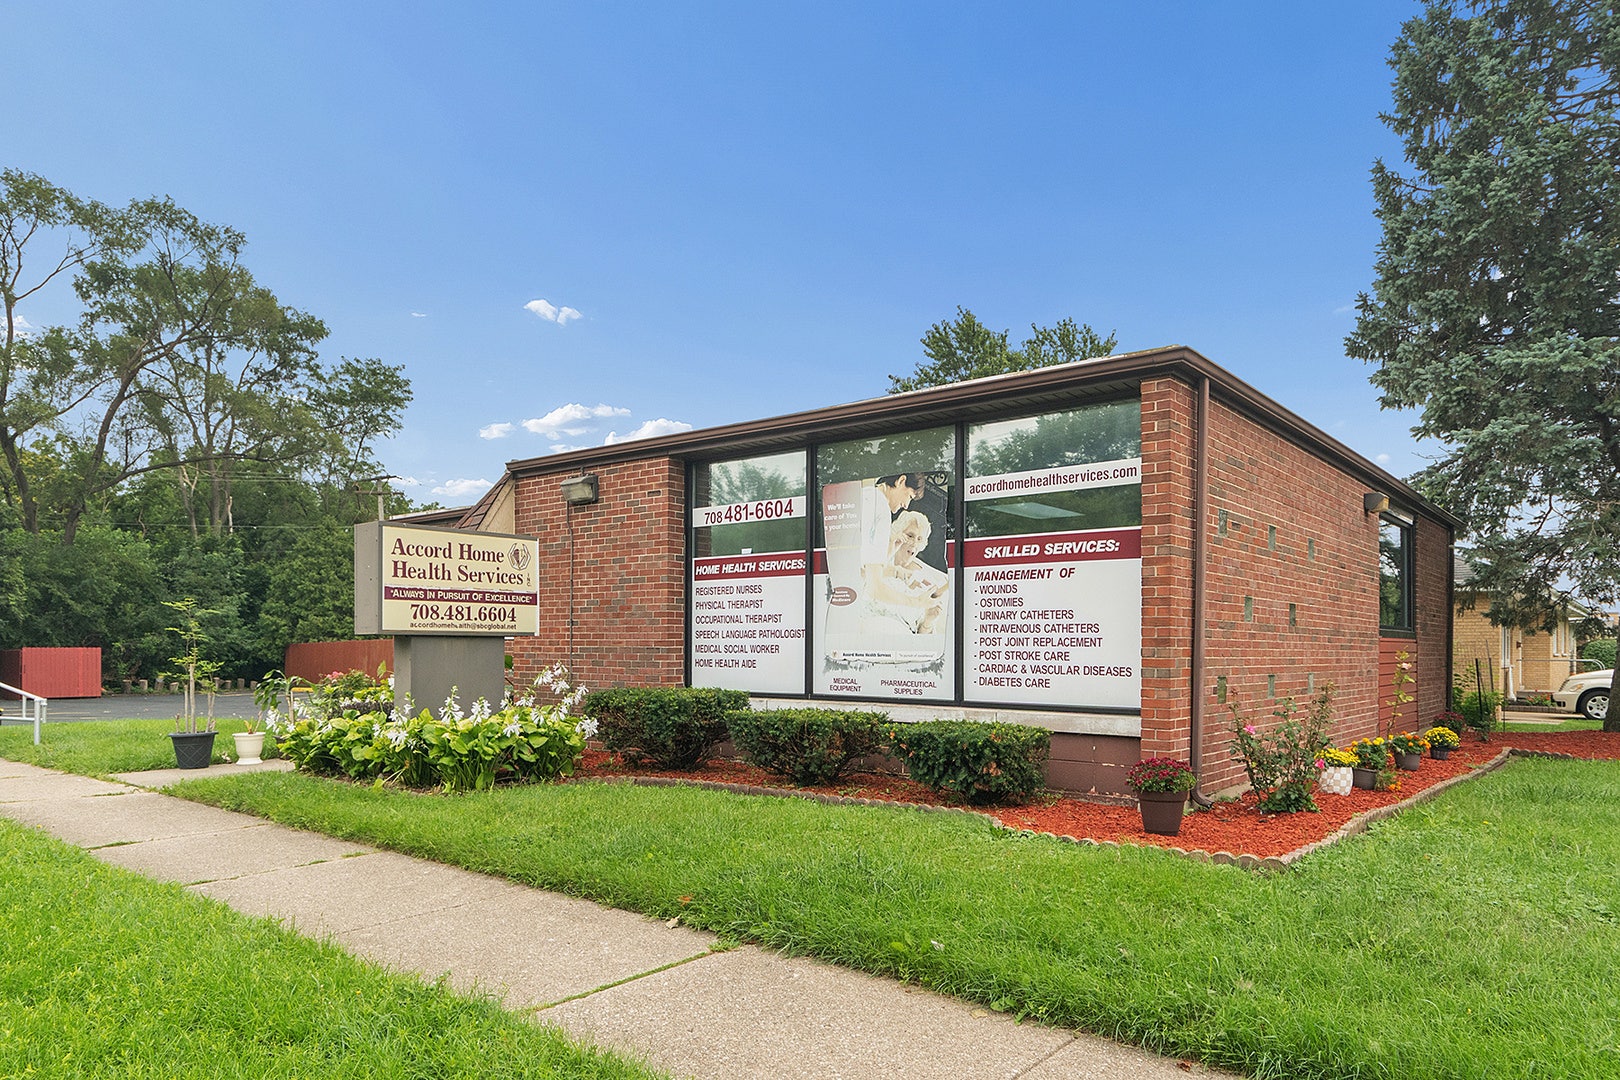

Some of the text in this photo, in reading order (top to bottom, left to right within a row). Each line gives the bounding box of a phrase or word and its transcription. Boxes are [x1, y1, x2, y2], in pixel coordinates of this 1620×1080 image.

[969, 465, 1138, 495] accordhomehealthservices.com
[704, 498, 794, 525] 708 481-6604
[391, 538, 505, 563] Accord Home
[983, 539, 1120, 559] SKILLED SERVICES:
[392, 559, 524, 585] Health Services
[695, 559, 806, 575] HOME HEALTH SERVICES:
[974, 567, 1076, 582] MANAGEMENT OF
[695, 584, 763, 596] REGISTERED NURSES
[979, 584, 1018, 595] WOUNDS
[427, 590, 435, 599] IN
[437, 590, 470, 600] PURSUIT
[472, 592, 483, 601] OF
[695, 600, 764, 610] PHYSICAL THERAPIST
[979, 597, 1024, 608] OSTOMIES
[410, 604, 517, 622] 708.481.6604
[695, 613, 783, 624] OCCUPATIONAL THERAPIST
[979, 610, 1018, 621] URINARY
[1020, 609, 1074, 620] CATHETERS
[695, 629, 806, 639] SPEECH LANGUAGE PATHOLOGIST
[979, 623, 1041, 634] INTRAVENOUS
[1043, 623, 1100, 634] CATHETERS
[979, 637, 1002, 647] POST
[1004, 637, 1031, 647] JOINT
[1032, 637, 1103, 648] REPLACEMENT
[695, 645, 780, 654] MEDICAL SOCIAL WORKER
[979, 651, 1002, 661] POST
[1004, 651, 1041, 661] STROKE
[1043, 651, 1070, 662] CARE
[694, 659, 757, 668] HOME HEALTH AIDE
[979, 664, 1018, 674] CARDIAC
[1020, 664, 1027, 674] &
[1029, 664, 1080, 676] VASCULAR
[1083, 666, 1132, 677] DISEASES
[880, 680, 937, 688] PHARMACEUTICAL
[979, 677, 1022, 687] DIABETES
[1025, 678, 1050, 688] CARE
[894, 688, 923, 696] SUPPLIES
